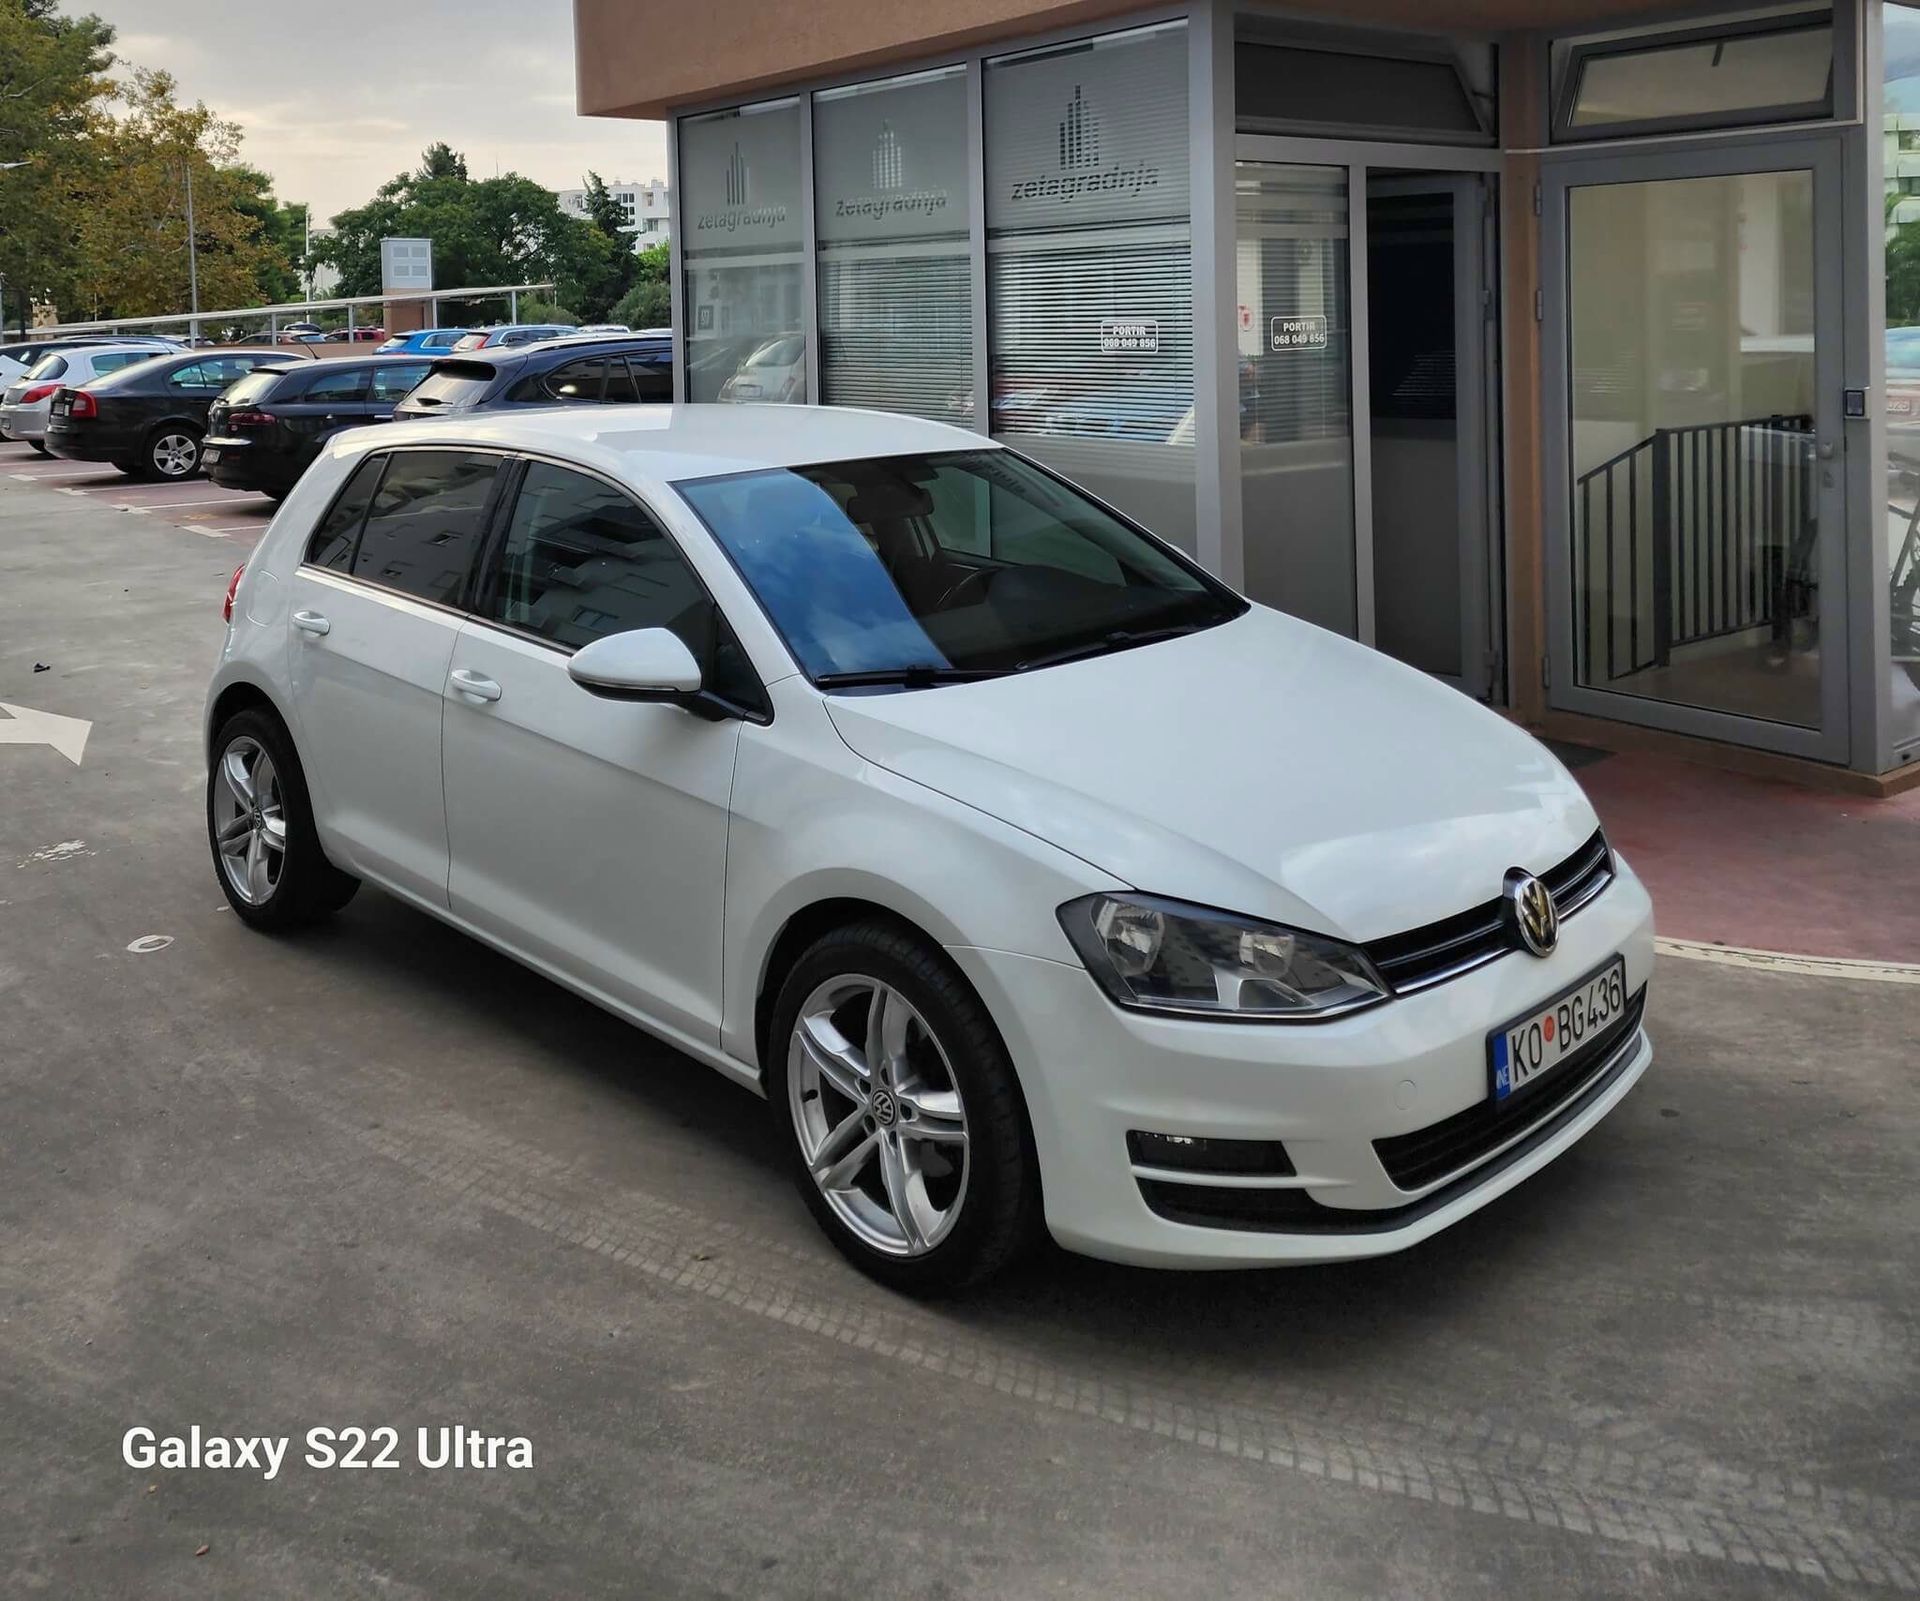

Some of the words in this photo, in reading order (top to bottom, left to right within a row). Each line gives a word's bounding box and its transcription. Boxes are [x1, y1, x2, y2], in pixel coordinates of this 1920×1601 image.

[1113, 326, 1146, 336] PORTIR
[1283, 321, 1315, 332] PORTIR
[1512, 1022, 1543, 1083] KO
[1557, 969, 1621, 1053] BG436
